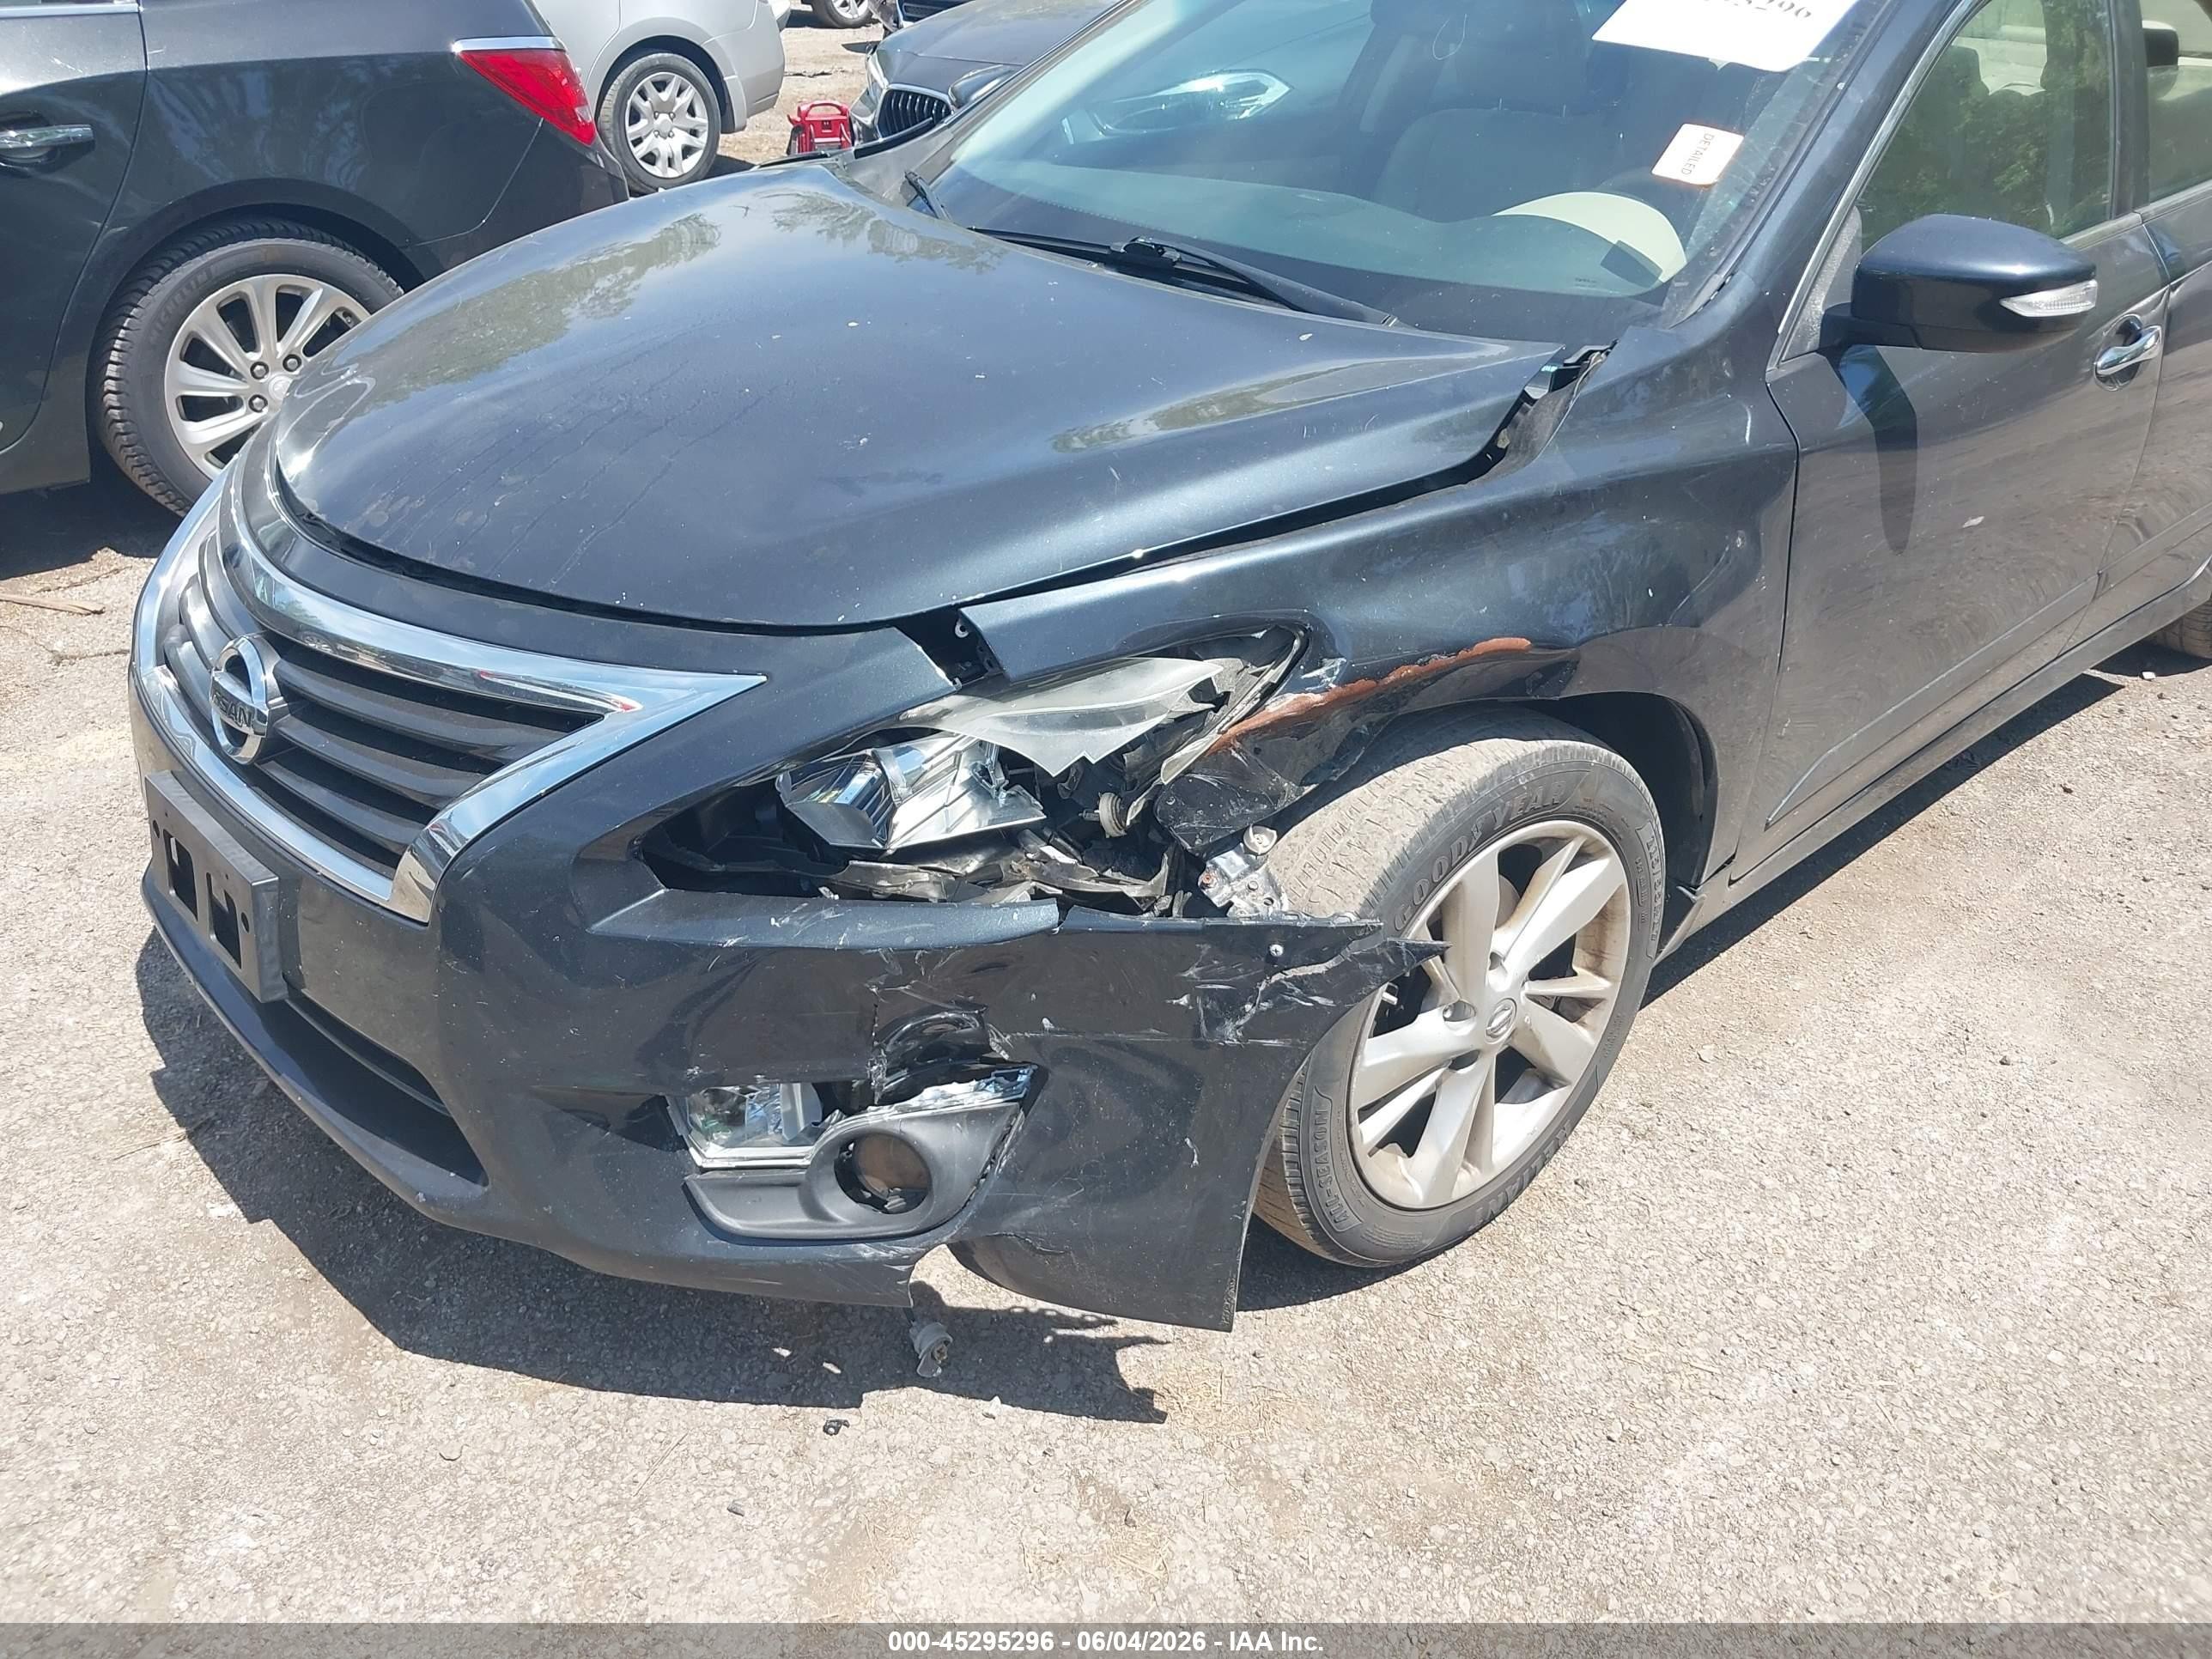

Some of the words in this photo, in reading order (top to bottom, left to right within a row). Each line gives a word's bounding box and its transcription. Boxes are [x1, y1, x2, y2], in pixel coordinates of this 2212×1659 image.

[1680, 132, 1714, 175] DETAILED
[211, 690, 252, 728] SSAN
[1394, 780, 1567, 931] GOODYEAR
[1313, 1108, 1350, 1224] ALL-SEASON
